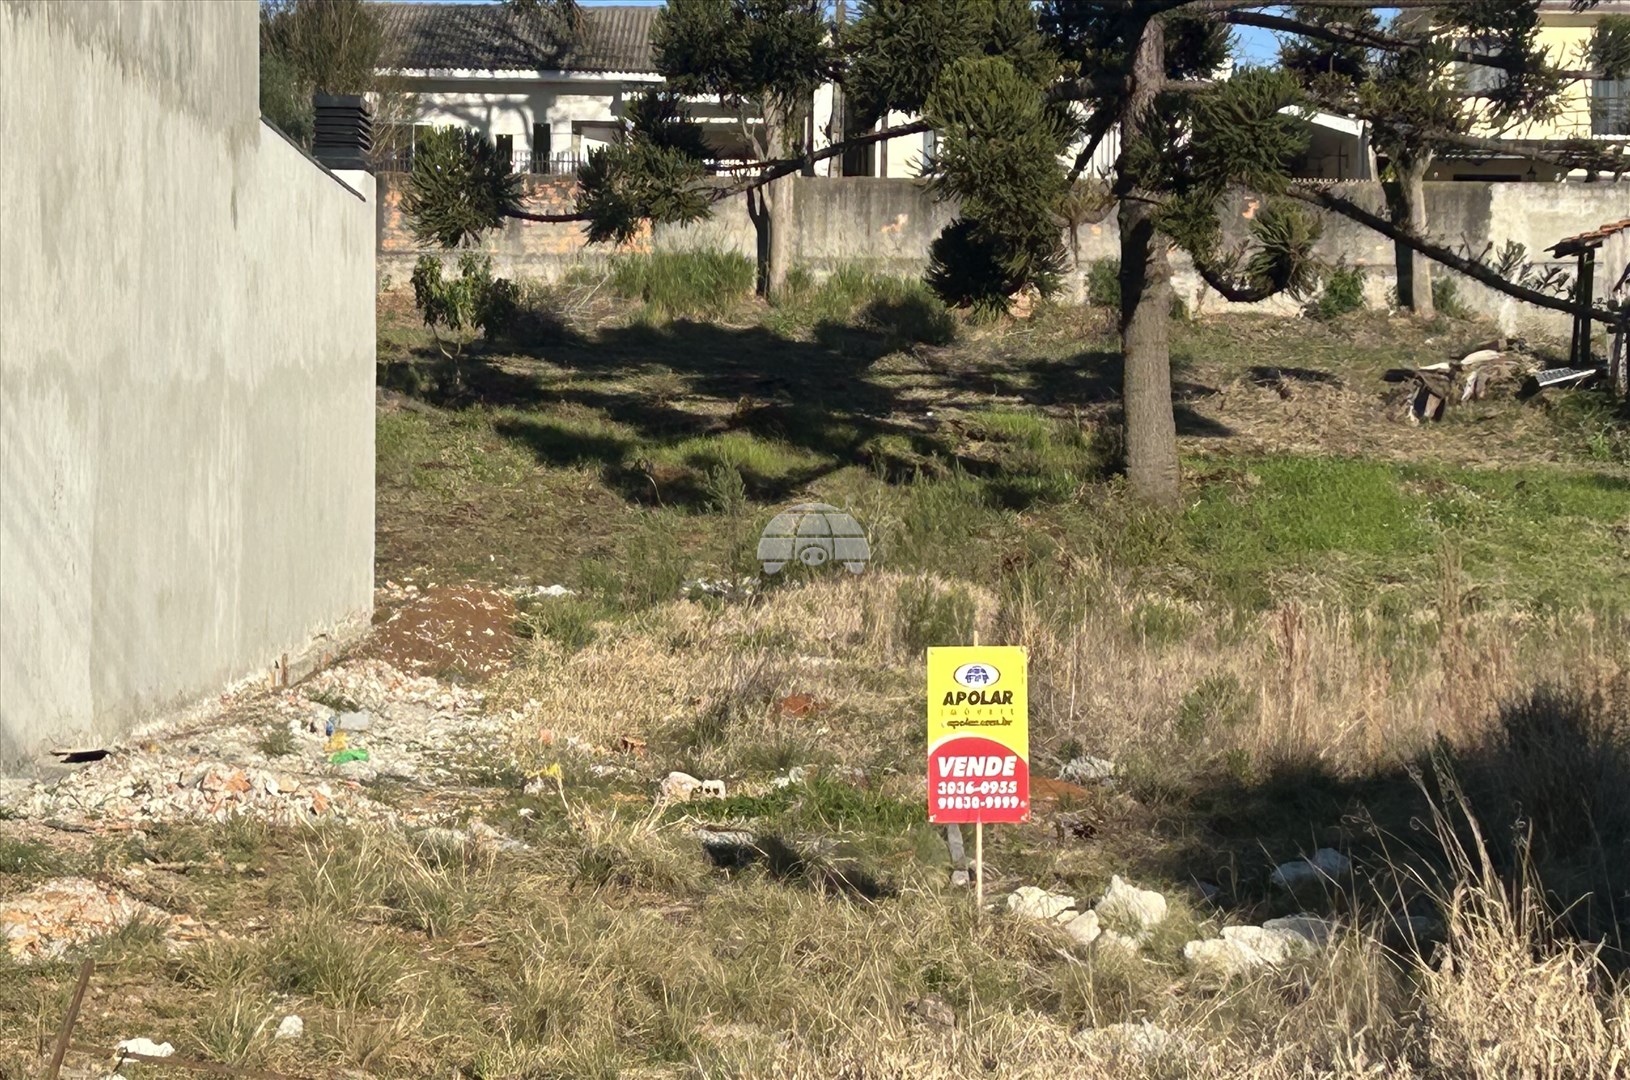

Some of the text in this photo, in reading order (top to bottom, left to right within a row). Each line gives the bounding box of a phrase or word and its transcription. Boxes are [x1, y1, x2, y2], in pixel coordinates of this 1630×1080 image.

[943, 690, 1013, 706] APOLAR
[938, 756, 1017, 778] VENDE
[938, 781, 1018, 794] 3036-0955
